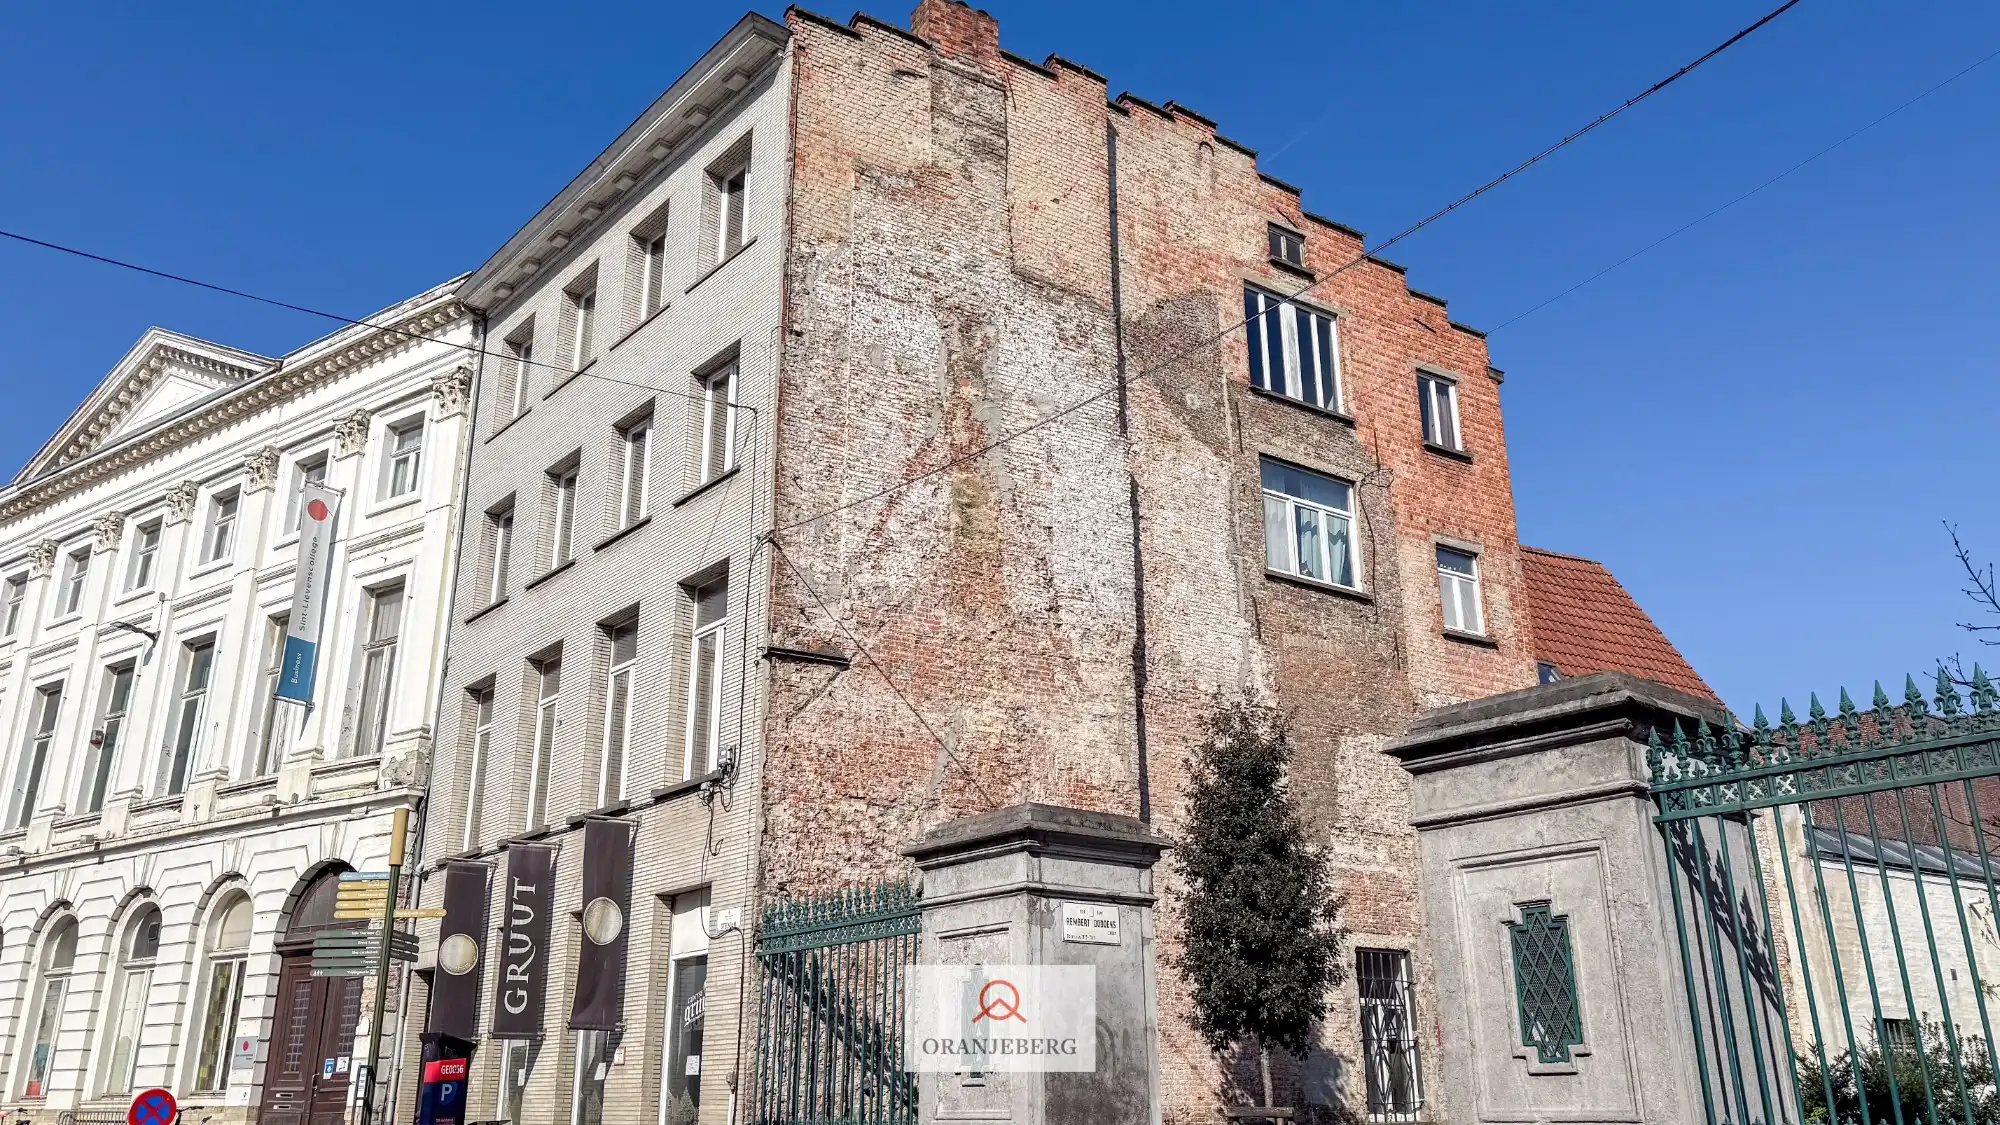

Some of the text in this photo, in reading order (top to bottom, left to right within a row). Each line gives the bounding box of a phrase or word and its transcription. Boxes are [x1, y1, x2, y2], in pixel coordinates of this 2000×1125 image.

[299, 535, 318, 632] Sint-Lievenscollege
[290, 652, 303, 684] Business
[504, 876, 537, 1015] GRUUT
[440, 1083, 453, 1102] P
